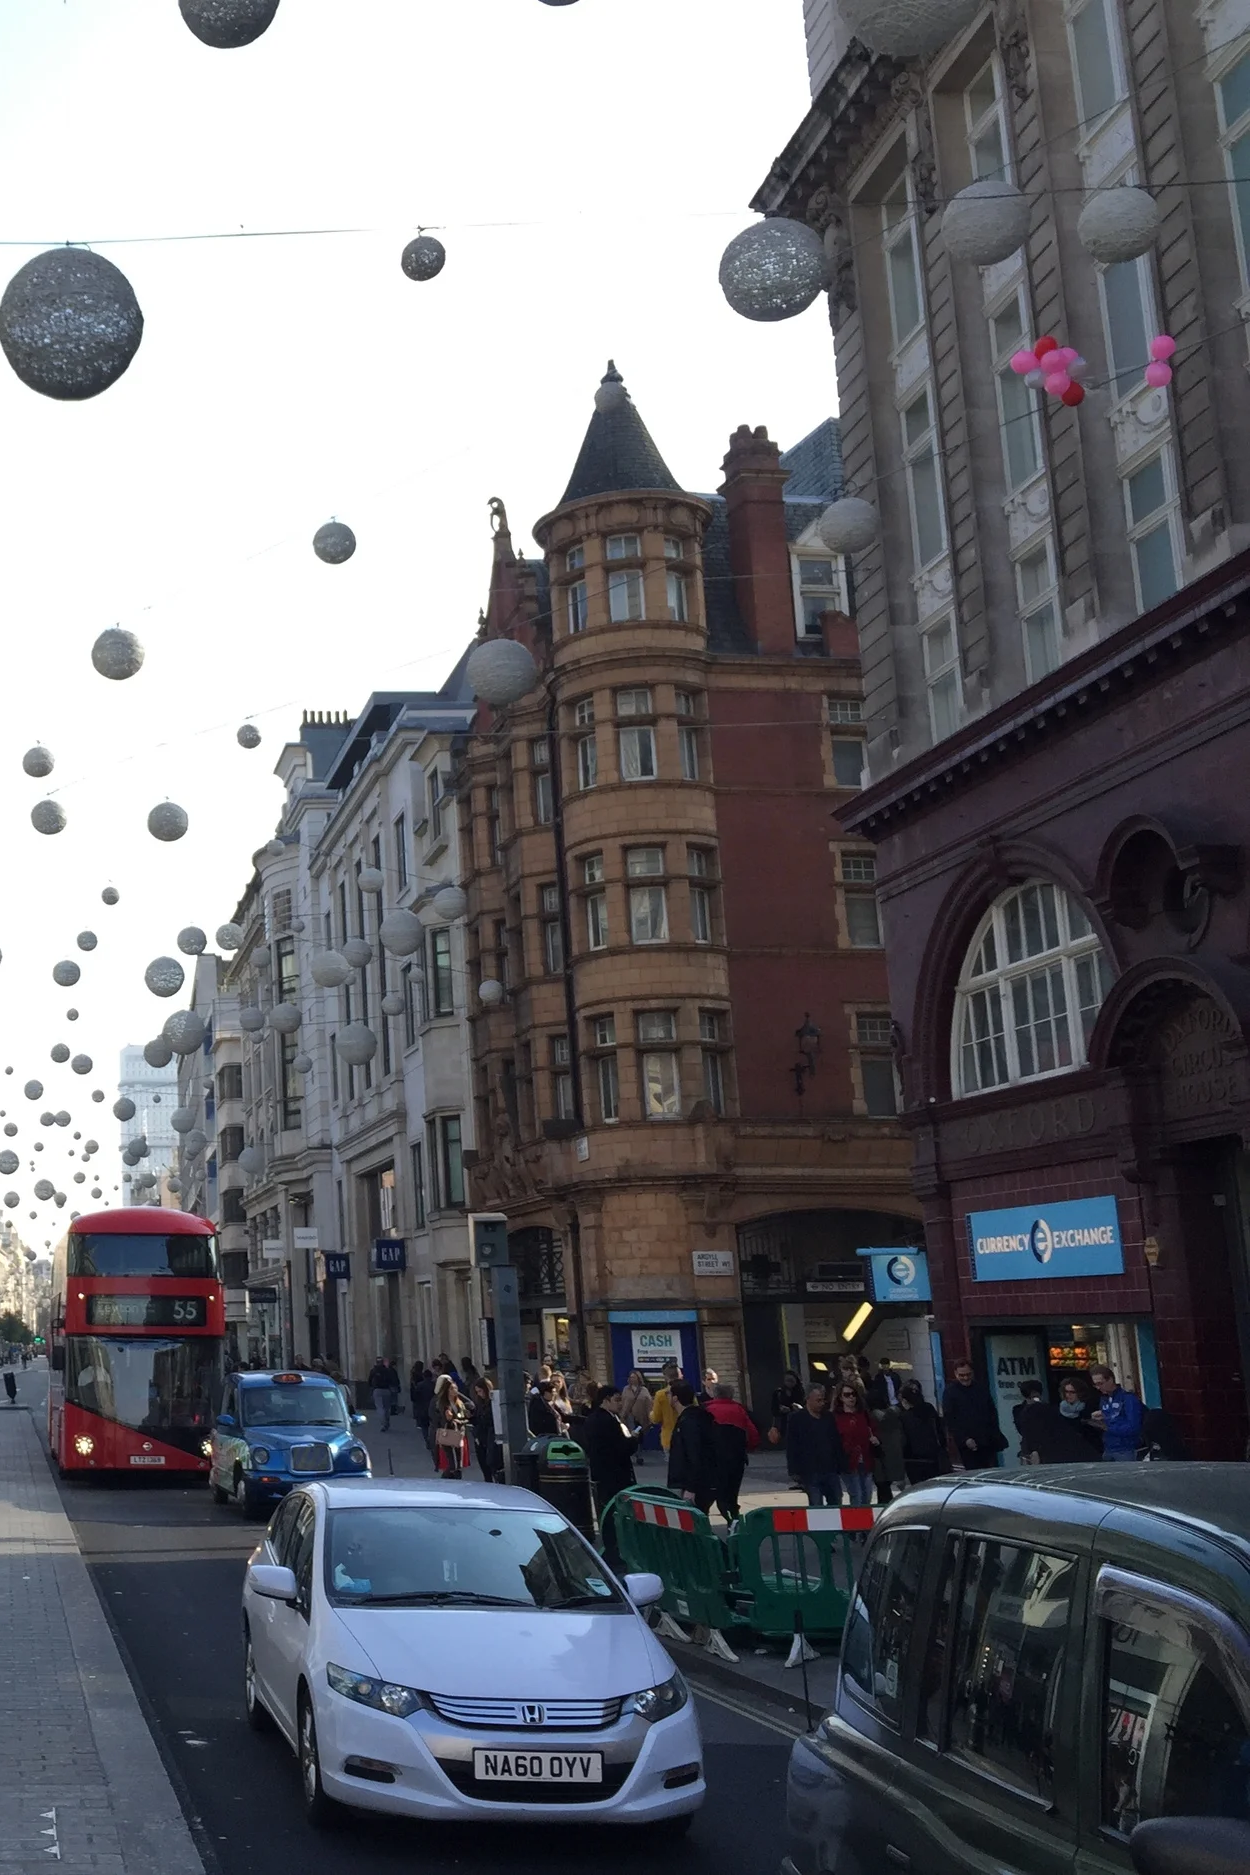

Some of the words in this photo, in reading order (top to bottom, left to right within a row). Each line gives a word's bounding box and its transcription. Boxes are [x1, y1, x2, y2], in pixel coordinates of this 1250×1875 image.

[962, 1097, 1096, 1152] OXFORD
[976, 1234, 1031, 1254] CURRENCY
[1054, 1226, 1115, 1248] EXCHANGE
[381, 1247, 400, 1262] GAP
[697, 1253, 718, 1261] ARGYLL
[329, 1260, 346, 1273] GAP
[821, 1282, 834, 1290] NO
[838, 1282, 860, 1290] ENTRY
[173, 1299, 197, 1320] 55
[639, 1334, 673, 1348] CASH
[996, 1356, 1036, 1376] ATM
[484, 1754, 543, 1778] NA60
[549, 1756, 592, 1779] OYV
